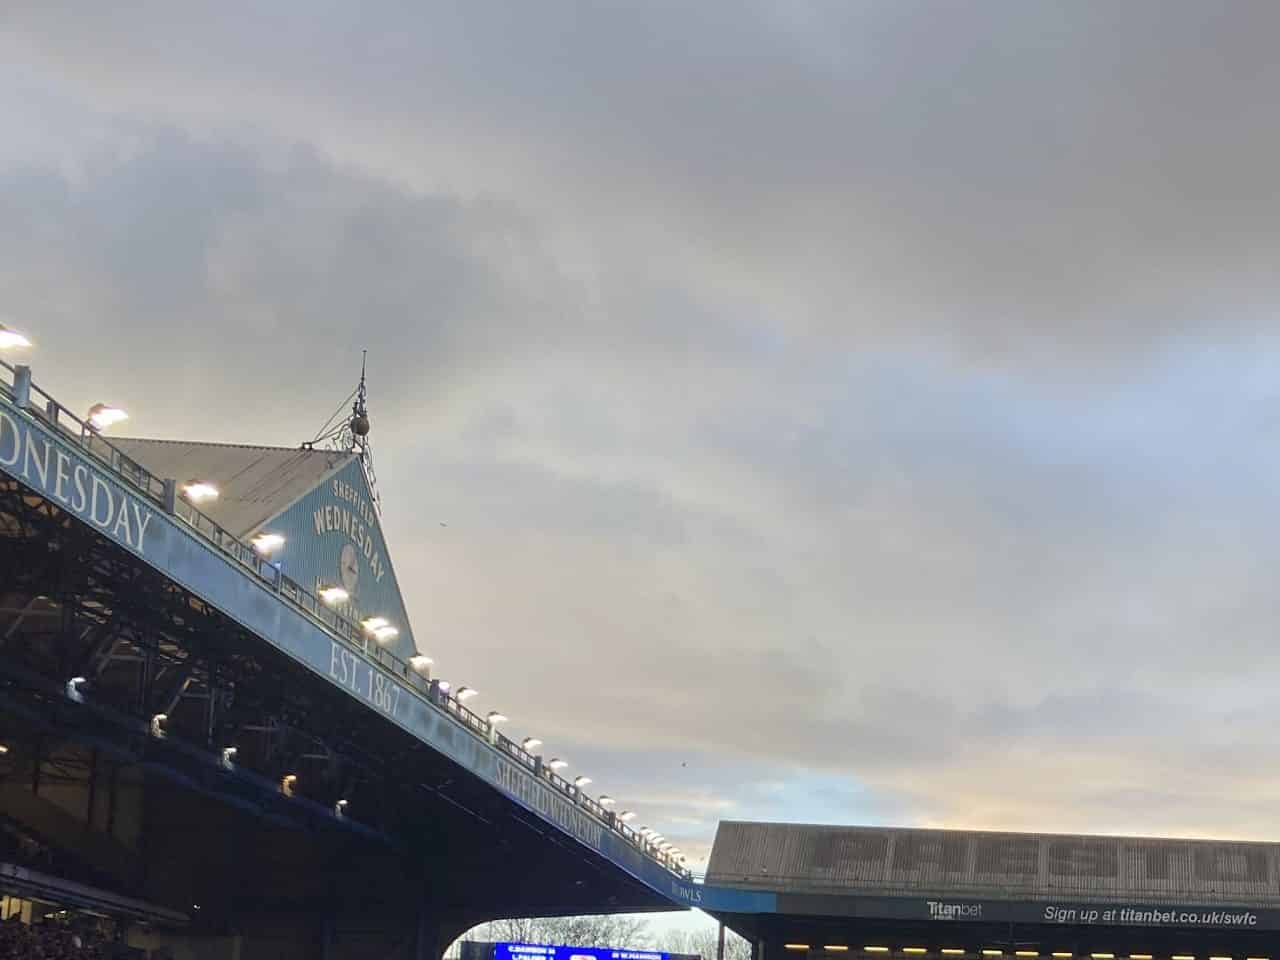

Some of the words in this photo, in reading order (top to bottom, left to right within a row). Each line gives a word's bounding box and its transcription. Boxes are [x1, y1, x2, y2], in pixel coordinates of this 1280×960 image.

[0, 411, 152, 552] DNESDAY
[333, 479, 374, 528] SHEFFIELD
[313, 504, 384, 584] WEDNESDAY
[328, 642, 361, 695] EST.
[367, 663, 402, 717] 1867
[926, 900, 983, 917] Titanbet
[1044, 906, 1077, 924] Sign
[1080, 909, 1098, 923] up
[1102, 909, 1116, 921] at
[1120, 909, 1257, 926] titanbet.co.uk/swfc
